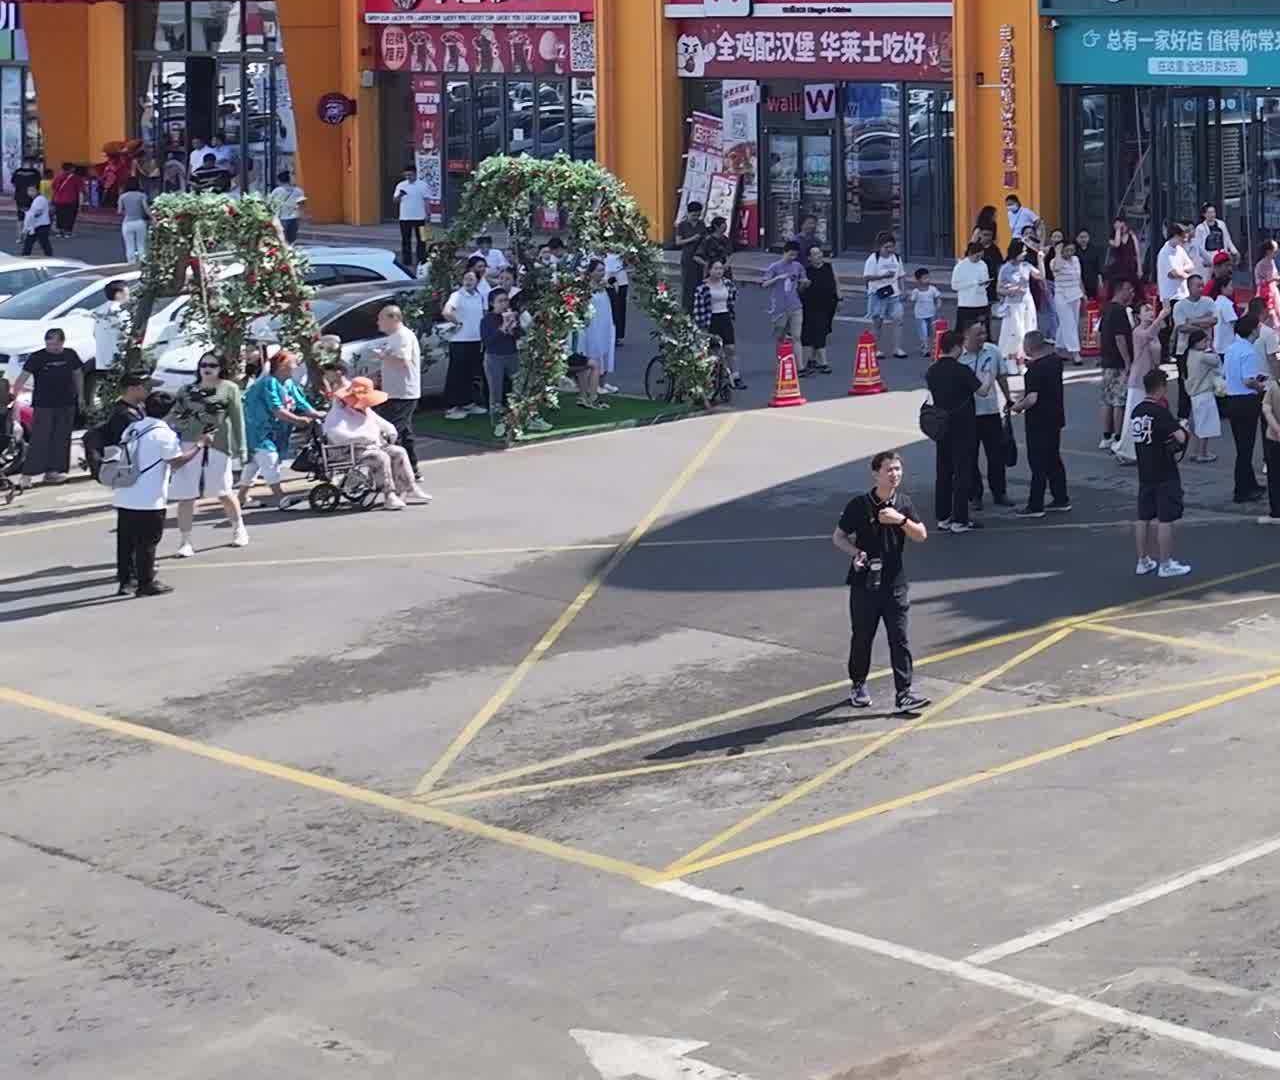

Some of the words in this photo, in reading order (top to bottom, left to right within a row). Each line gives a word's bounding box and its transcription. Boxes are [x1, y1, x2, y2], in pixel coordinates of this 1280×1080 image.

[715, 31, 816, 63] 全鸡配汉堡
[820, 30, 927, 64] 华莱士吃好
[1106, 29, 1204, 53] 总有一家好店
